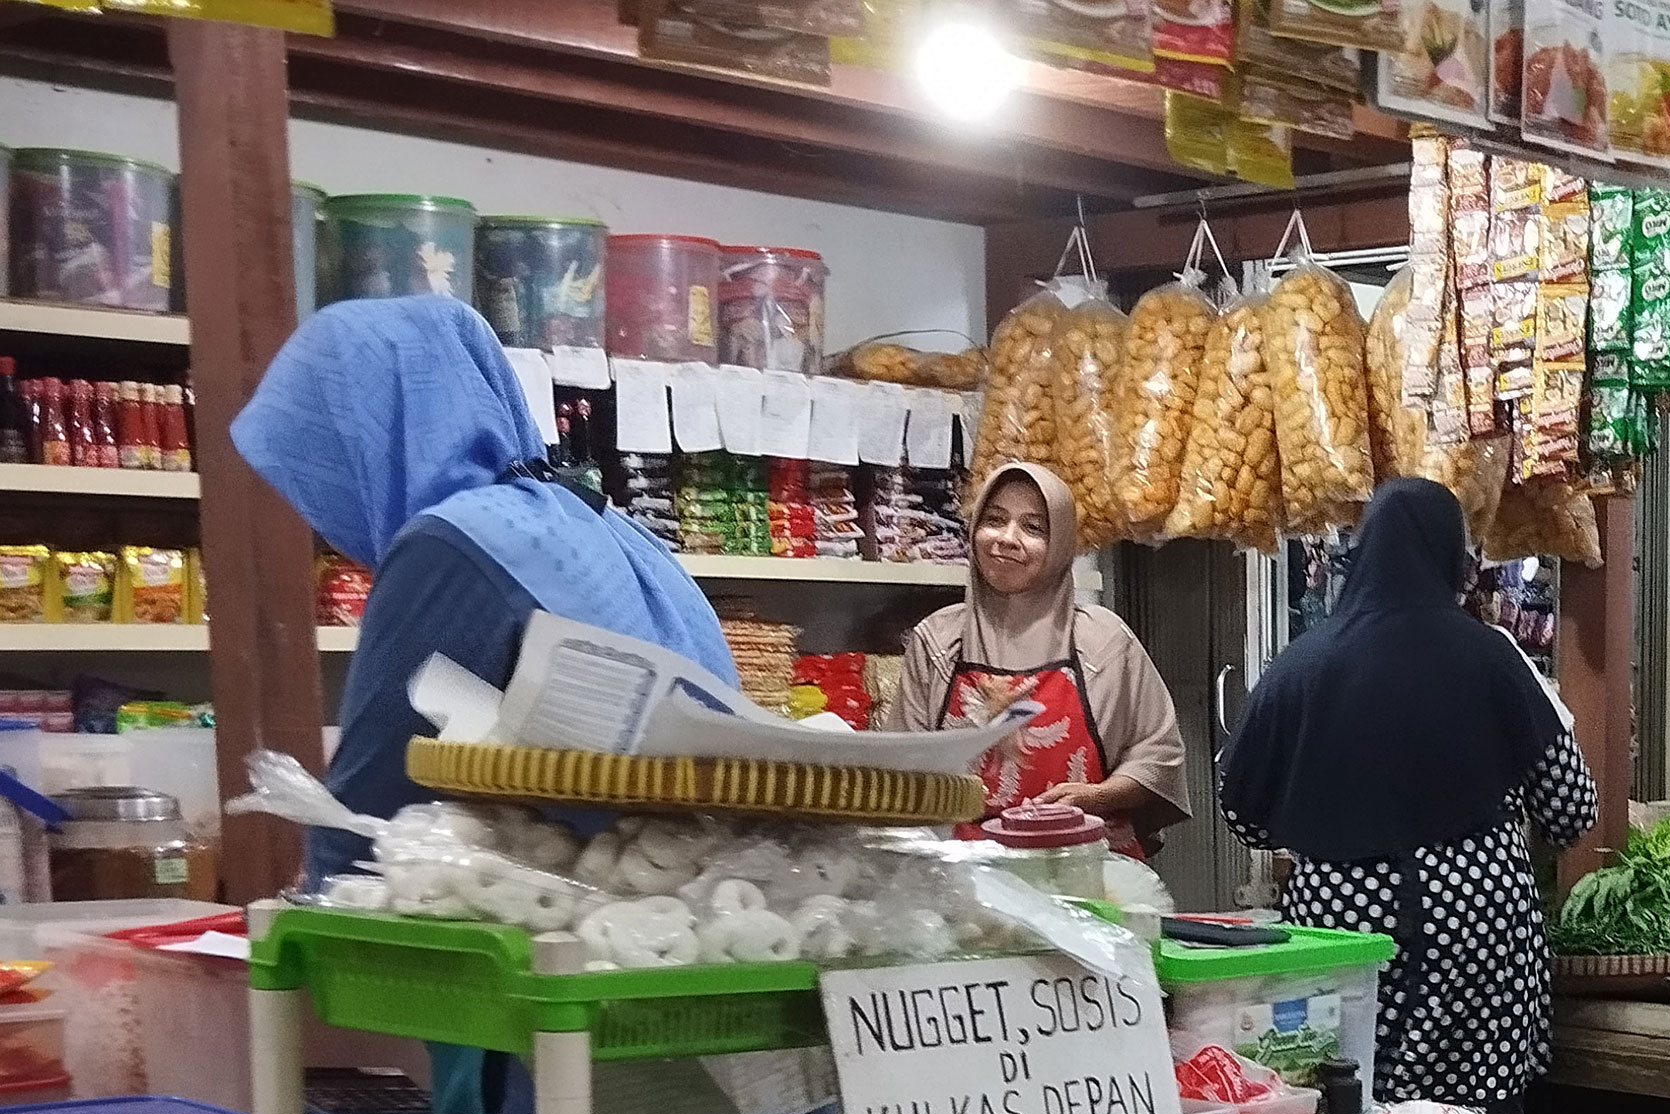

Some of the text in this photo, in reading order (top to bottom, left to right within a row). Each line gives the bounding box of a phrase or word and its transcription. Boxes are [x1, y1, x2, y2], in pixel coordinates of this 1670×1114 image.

[849, 975, 1142, 1056] NUGGET, SOSIS
[999, 1050, 1031, 1083] DI
